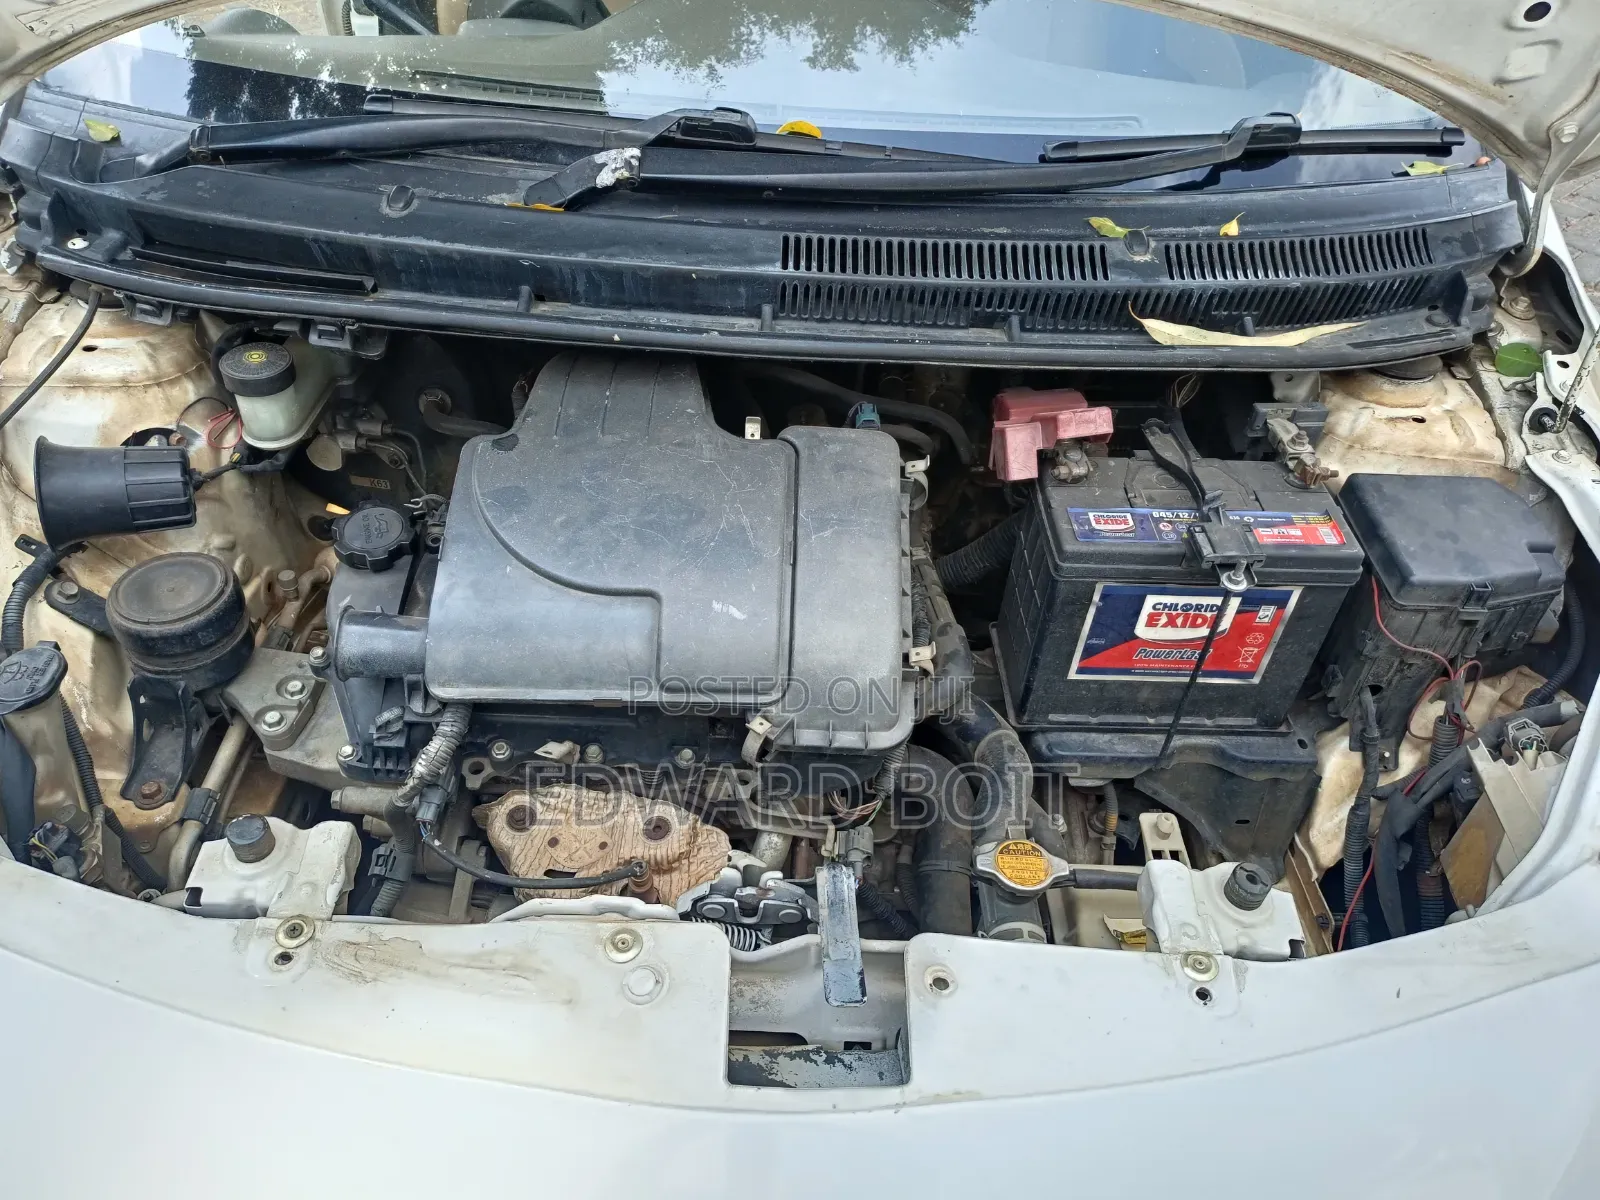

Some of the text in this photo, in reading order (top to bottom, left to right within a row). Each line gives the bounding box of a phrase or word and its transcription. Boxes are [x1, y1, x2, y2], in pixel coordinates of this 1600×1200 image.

[370, 479, 388, 489] K63
[1094, 518, 1131, 526] EXIDE
[1151, 602, 1223, 613] CHLORID
[1003, 849, 1041, 857] CAUTION
